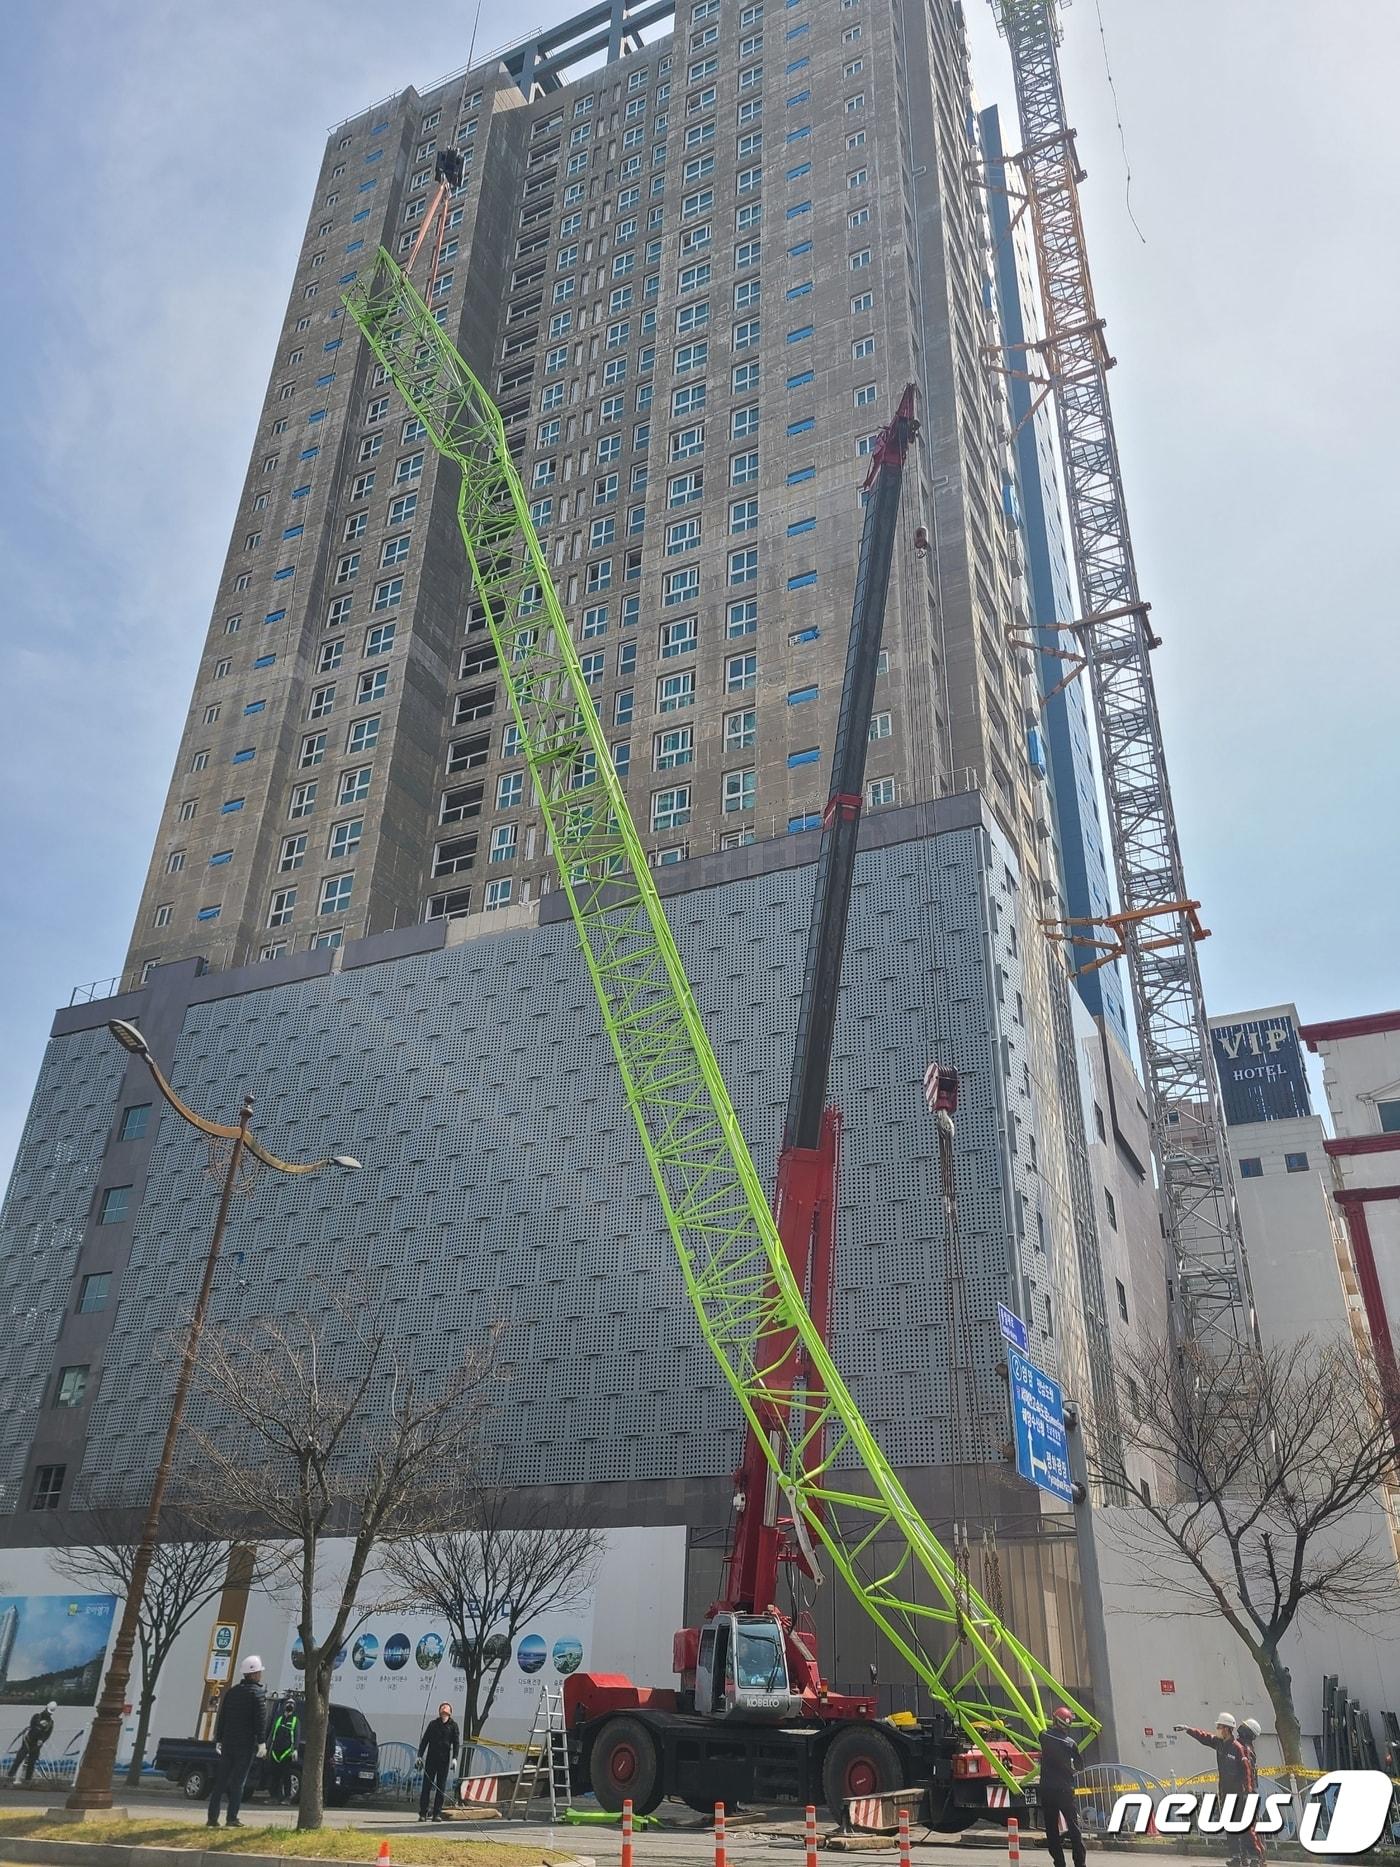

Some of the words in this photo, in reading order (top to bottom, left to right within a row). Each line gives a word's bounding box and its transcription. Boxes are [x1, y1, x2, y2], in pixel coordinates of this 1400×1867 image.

[1218, 1029, 1287, 1060] VIP
[1233, 1064, 1287, 1081] HOTEL
[746, 1698, 780, 1708] KOBELCO
